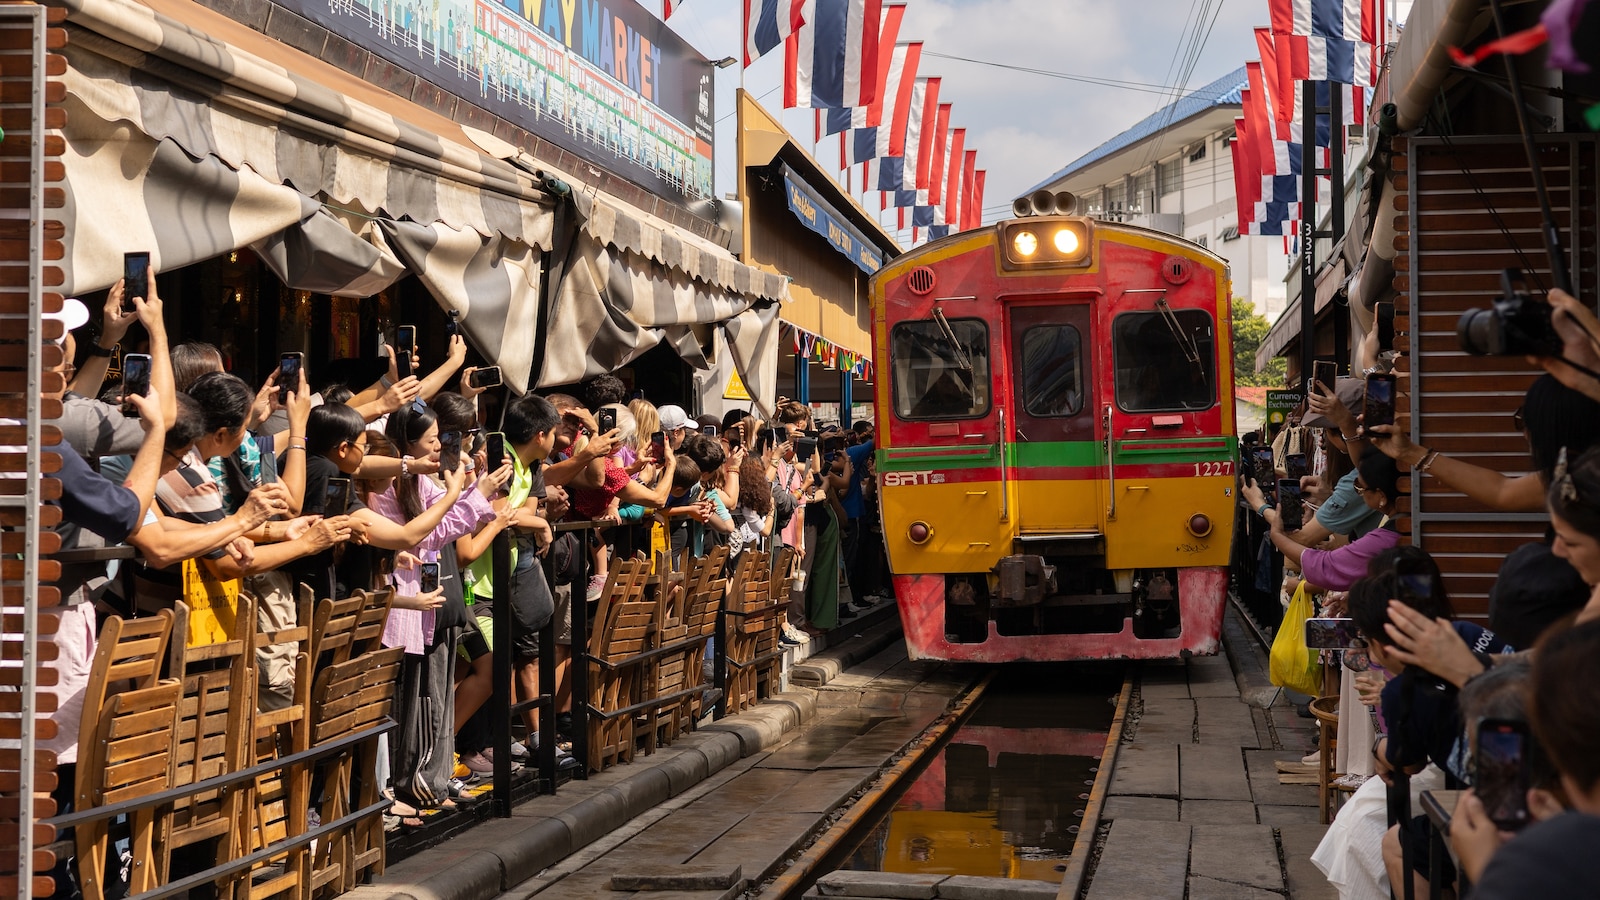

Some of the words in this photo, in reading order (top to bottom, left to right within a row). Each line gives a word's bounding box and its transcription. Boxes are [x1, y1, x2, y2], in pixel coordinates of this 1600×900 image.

[496, 0, 576, 49] AY
[582, 0, 661, 106] MARKET
[1268, 392, 1301, 401] Currency
[1193, 461, 1232, 477] 1227
[884, 470, 933, 486] SRT
